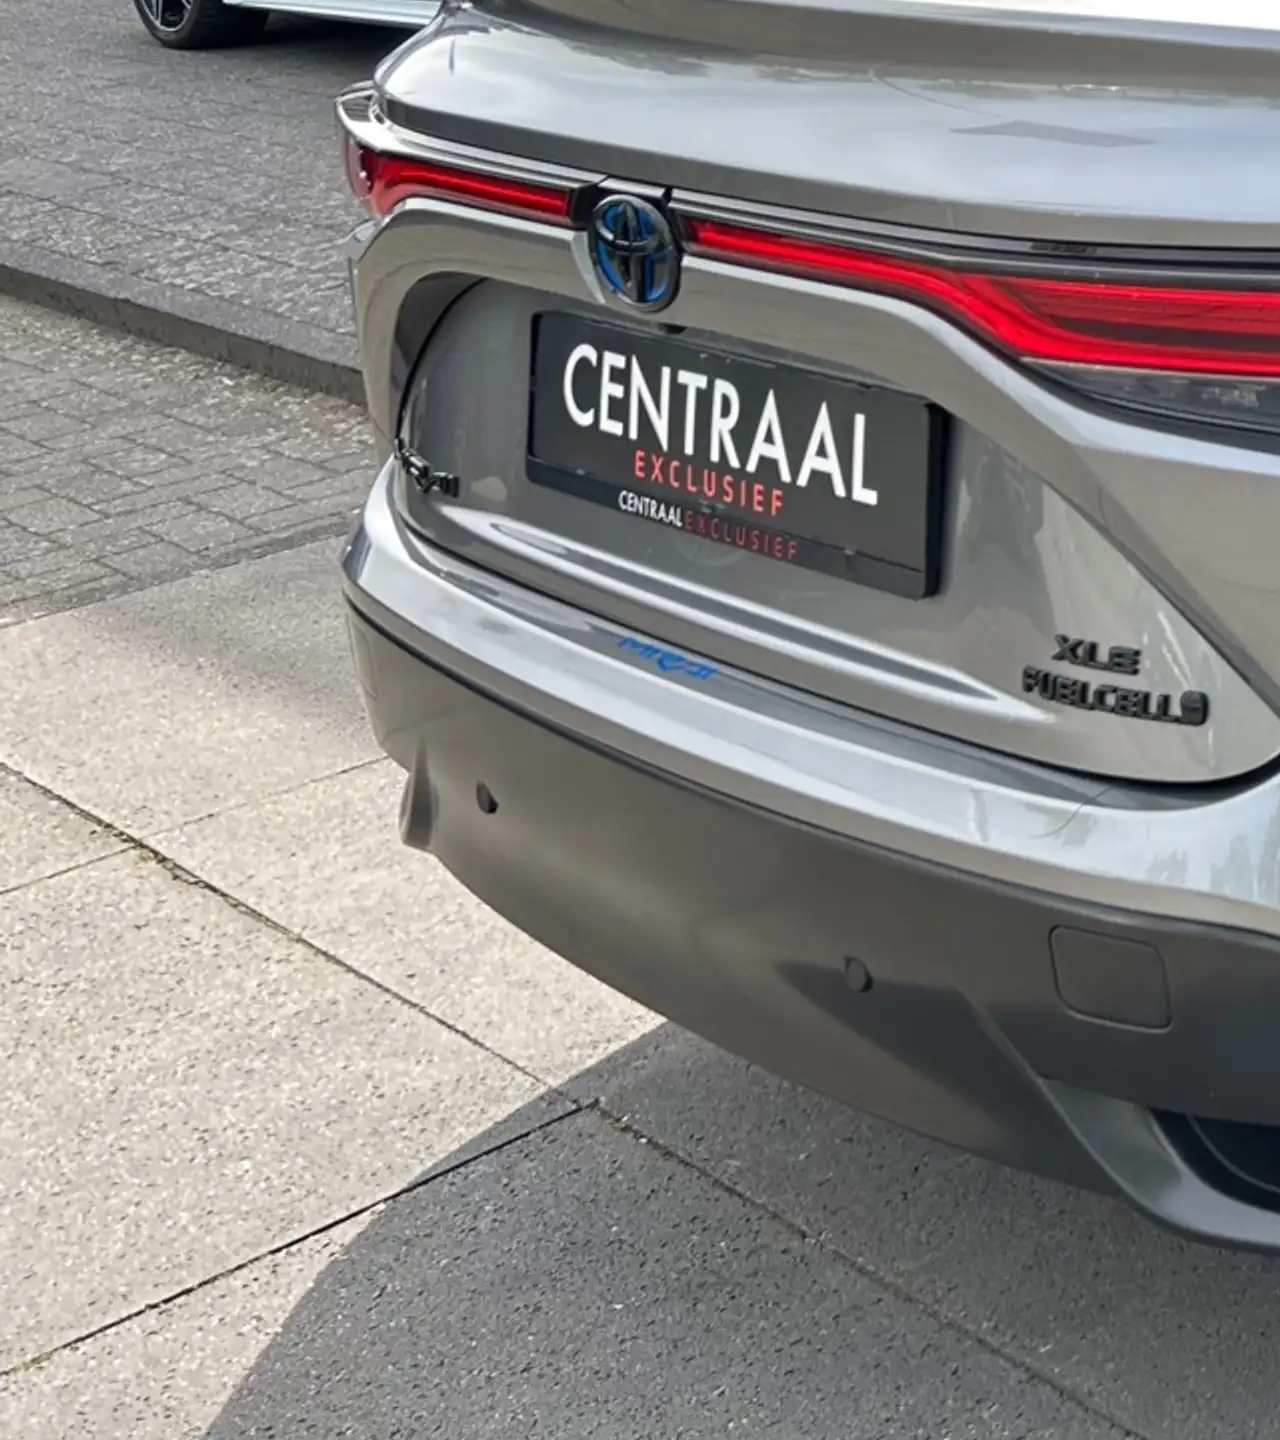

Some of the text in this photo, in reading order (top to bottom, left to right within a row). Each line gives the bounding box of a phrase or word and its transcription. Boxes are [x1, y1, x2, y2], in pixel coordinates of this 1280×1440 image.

[563, 343, 878, 506] CENTRAAL
[633, 449, 784, 516] EXCLUSIEF
[1052, 634, 1142, 676] XLE
